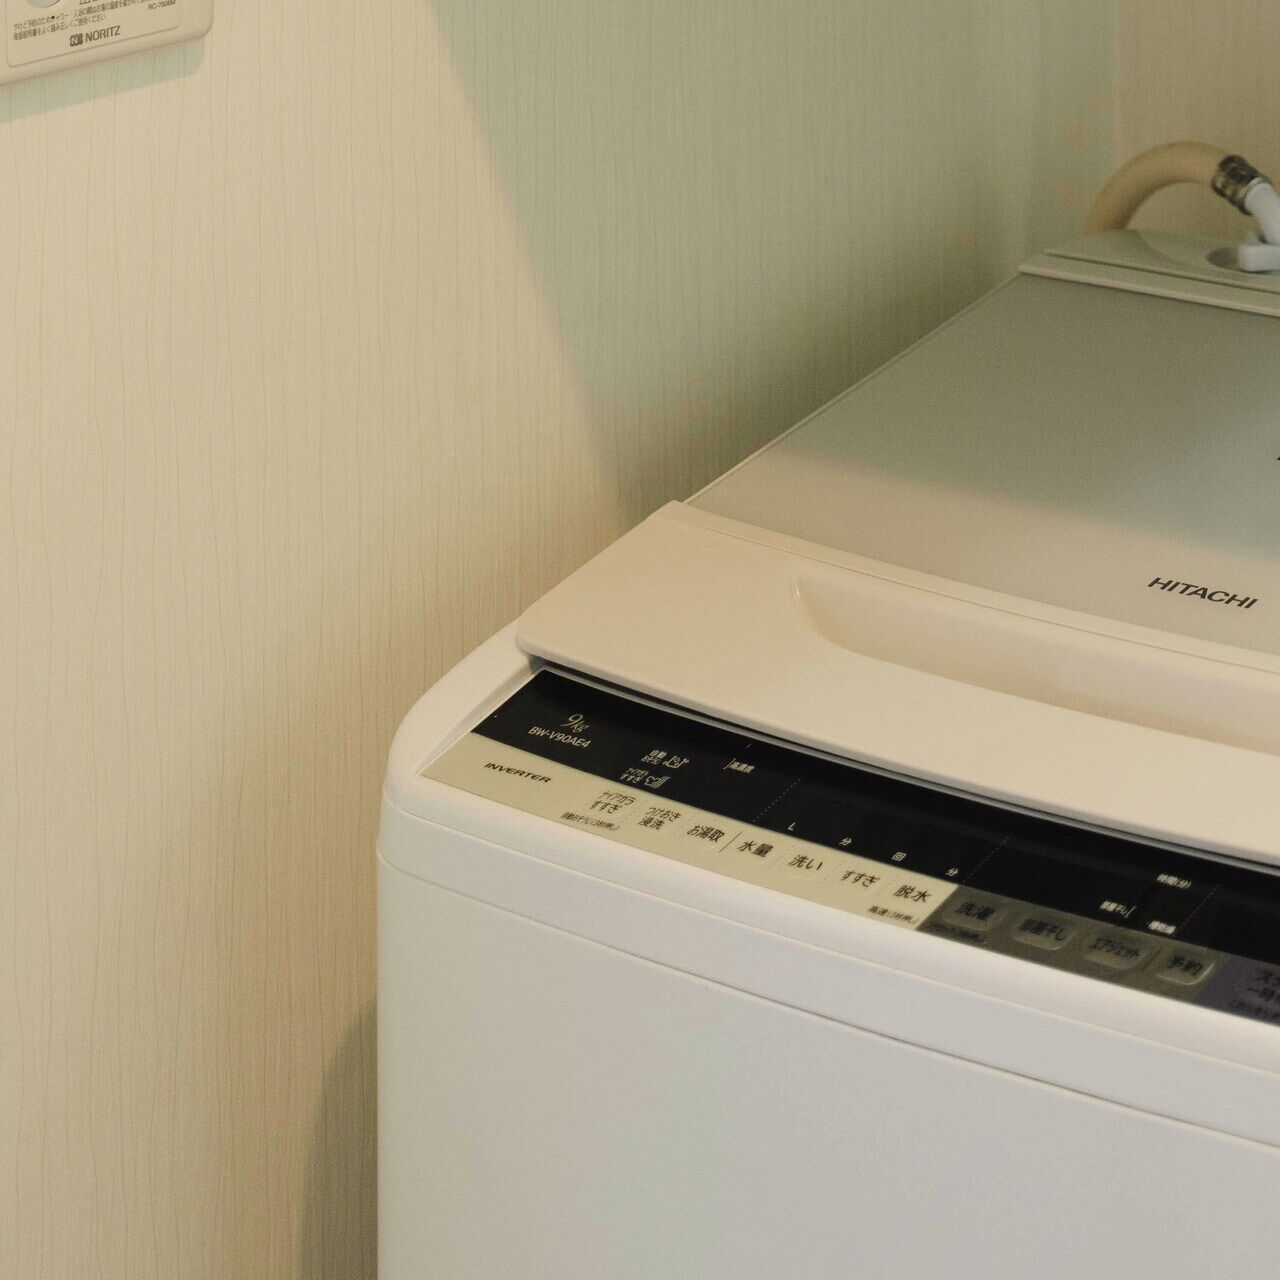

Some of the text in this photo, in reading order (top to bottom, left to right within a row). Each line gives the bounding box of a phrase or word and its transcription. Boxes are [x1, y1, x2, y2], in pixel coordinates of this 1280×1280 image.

[85, 25, 120, 42] NORITZ
[1146, 576, 1260, 610] HITACHI
[527, 725, 592, 749] BW-V90AE4
[484, 761, 552, 784] INVERTER
[589, 800, 622, 814] すすぎ
[646, 807, 682, 823] つけおき
[686, 824, 725, 843] お湯取
[736, 840, 775, 860] 水量
[891, 851, 907, 862] 回
[787, 853, 823, 872] 洗い
[840, 869, 881, 889] すすぎ
[893, 884, 933, 904] 脱水
